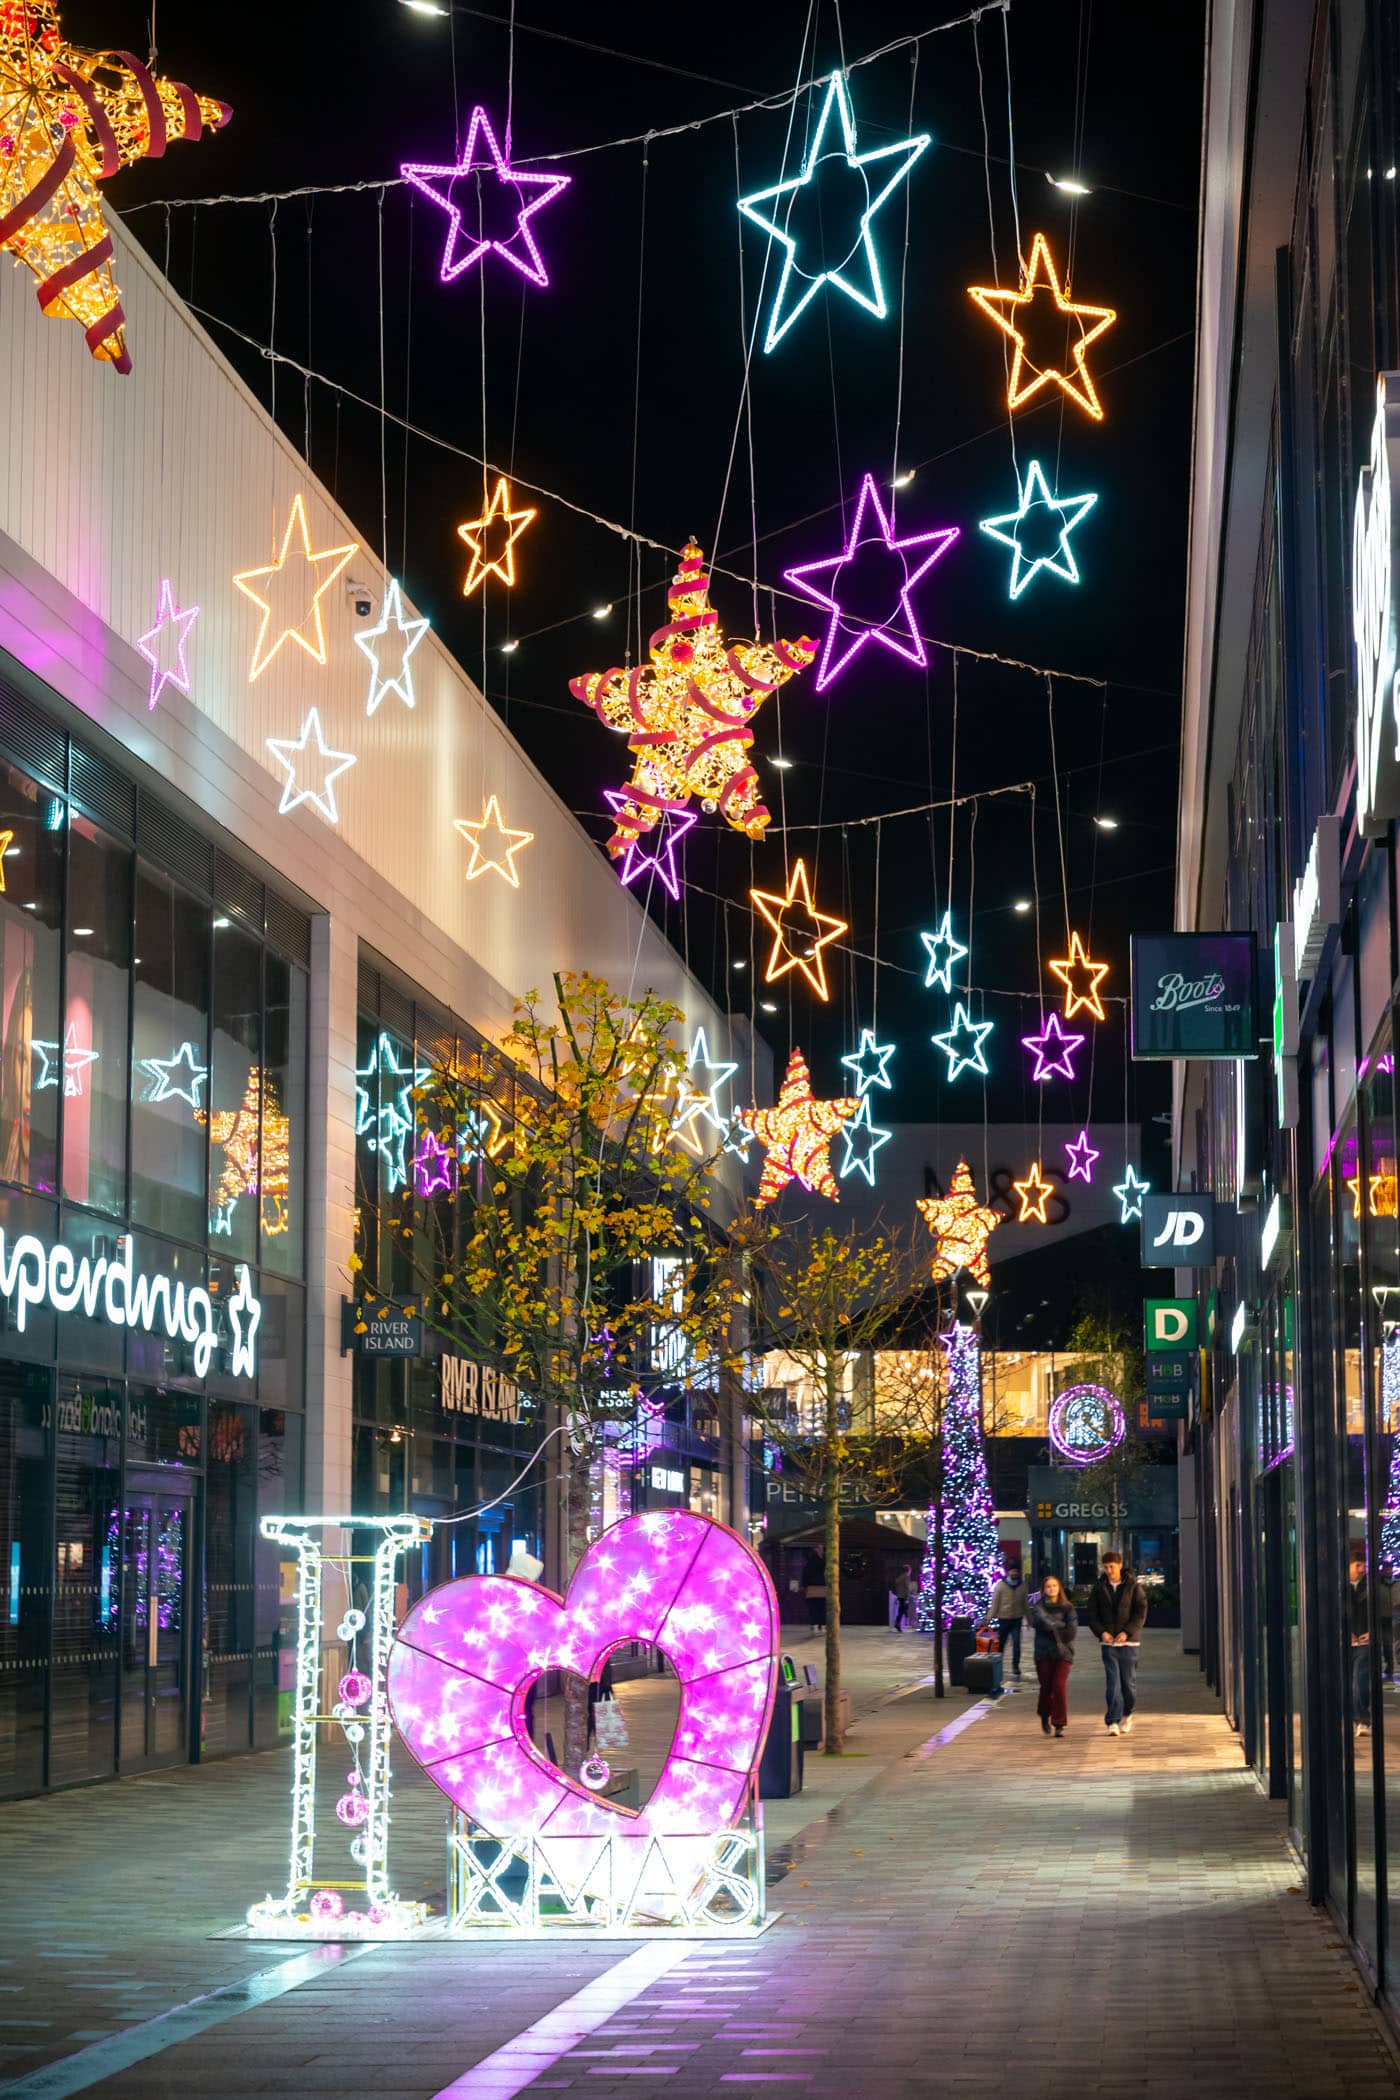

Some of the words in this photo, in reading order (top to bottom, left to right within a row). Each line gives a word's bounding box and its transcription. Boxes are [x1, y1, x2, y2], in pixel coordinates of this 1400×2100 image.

[1150, 973, 1225, 1011] Boots
[1204, 1004, 1222, 1012] Since
[1224, 1004, 1240, 1012] 1849
[1153, 1211, 1205, 1247] JD
[370, 1322, 409, 1334] RIVER
[1154, 1308, 1188, 1341] D
[365, 1337, 414, 1350] ISLAND
[441, 1353, 479, 1415] RIVER
[481, 1364, 521, 1424] ISLAND
[448, 1832, 761, 1930] XMAS
